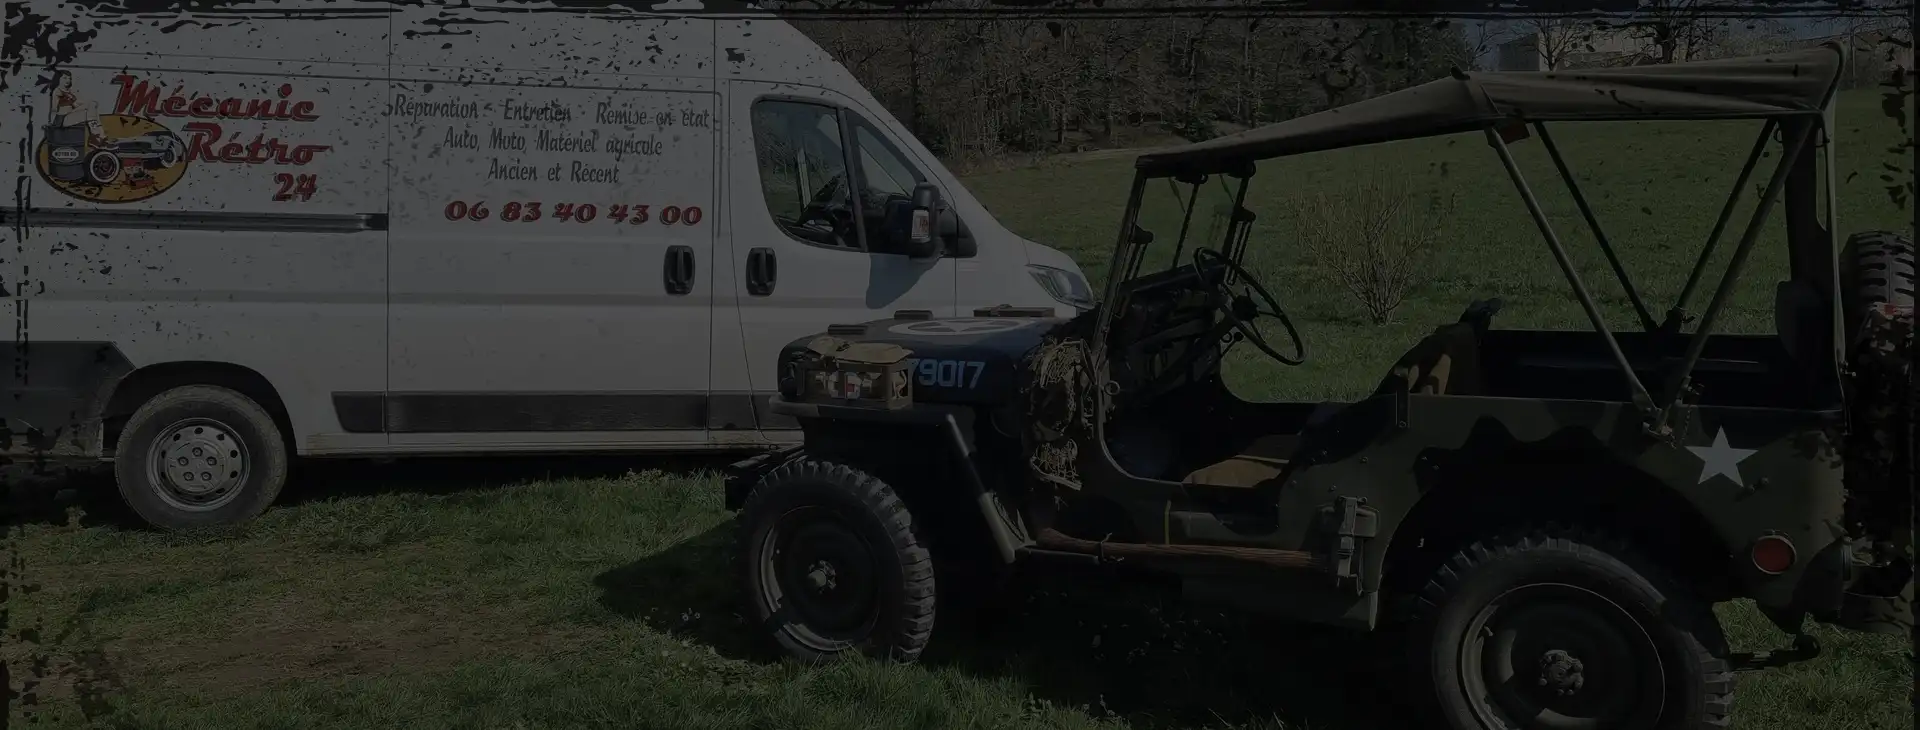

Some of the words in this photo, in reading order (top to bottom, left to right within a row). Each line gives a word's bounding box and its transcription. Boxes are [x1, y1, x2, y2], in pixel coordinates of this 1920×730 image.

[110, 74, 320, 122] Mécanic
[503, 98, 572, 122] Entretien
[182, 121, 334, 165] Rétro
[443, 125, 480, 151] Auto,
[488, 127, 527, 151] Moto,
[535, 129, 599, 153] Matériel
[606, 132, 663, 161] agricole
[488, 157, 538, 181] Ancien
[547, 165, 562, 182] et
[570, 160, 620, 184] Récent
[272, 172, 318, 202] 24
[444, 200, 490, 222] 06
[500, 201, 543, 223] 83
[552, 202, 598, 224] 40
[607, 204, 650, 226] 43
[659, 205, 703, 226] 00
